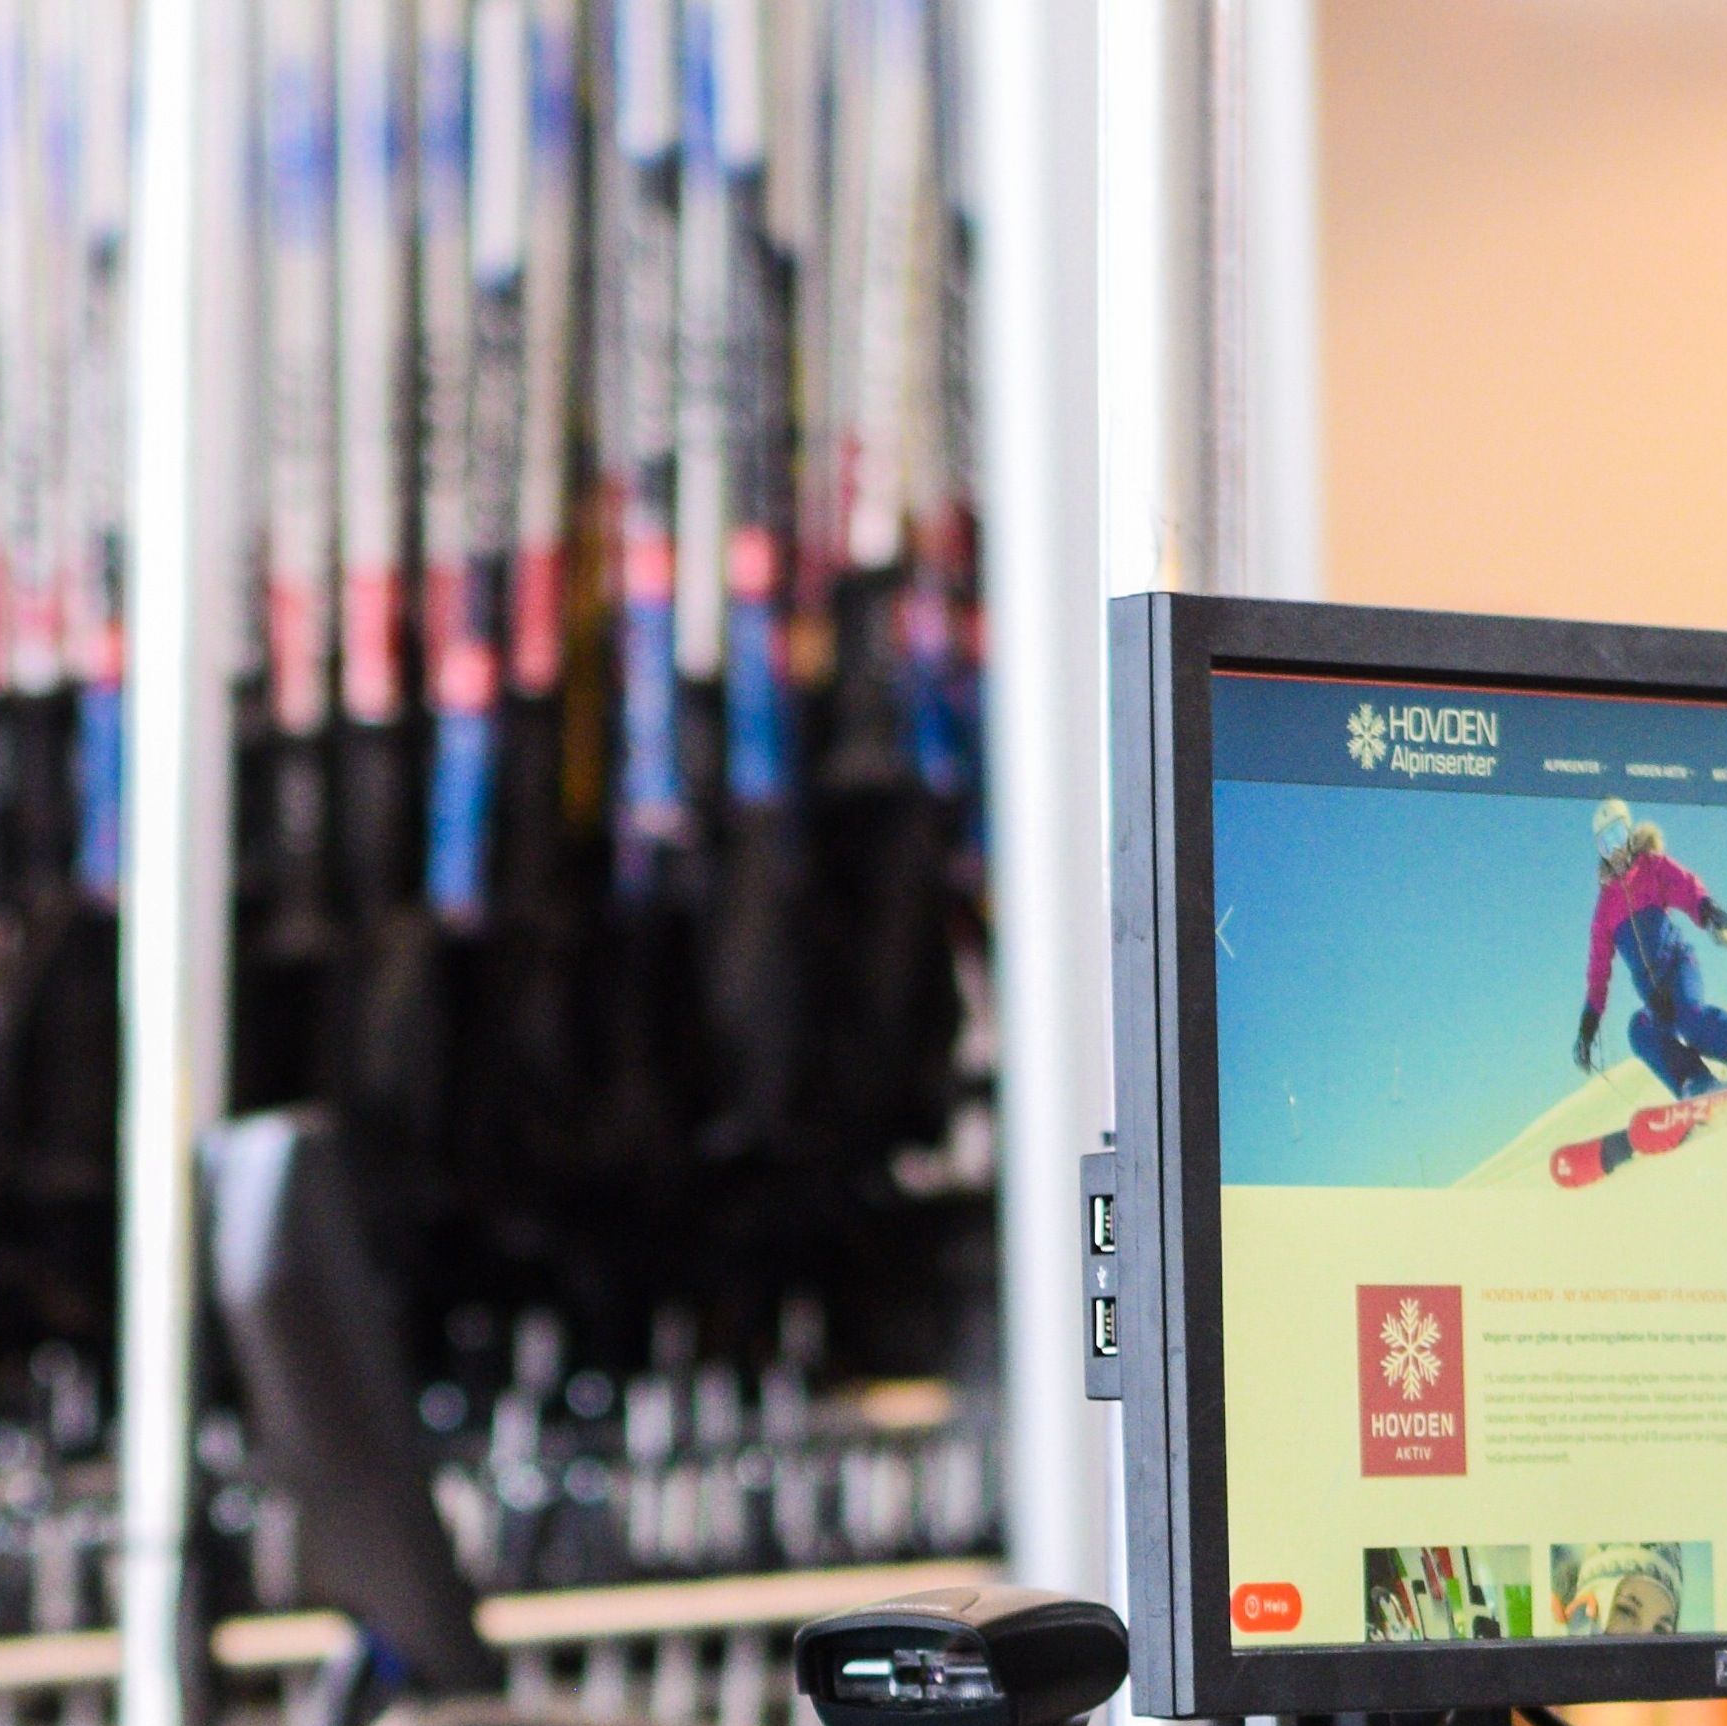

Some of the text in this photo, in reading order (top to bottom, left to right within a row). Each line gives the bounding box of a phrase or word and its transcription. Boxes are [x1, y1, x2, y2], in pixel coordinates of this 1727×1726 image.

[1389, 705, 1498, 747] HOVDEN
[1390, 744, 1497, 779] Alpinsenter
[1371, 1412, 1455, 1438] HOVDEN
[1395, 1446, 1431, 1461] AKTIV
[1263, 1599, 1290, 1616] Help
